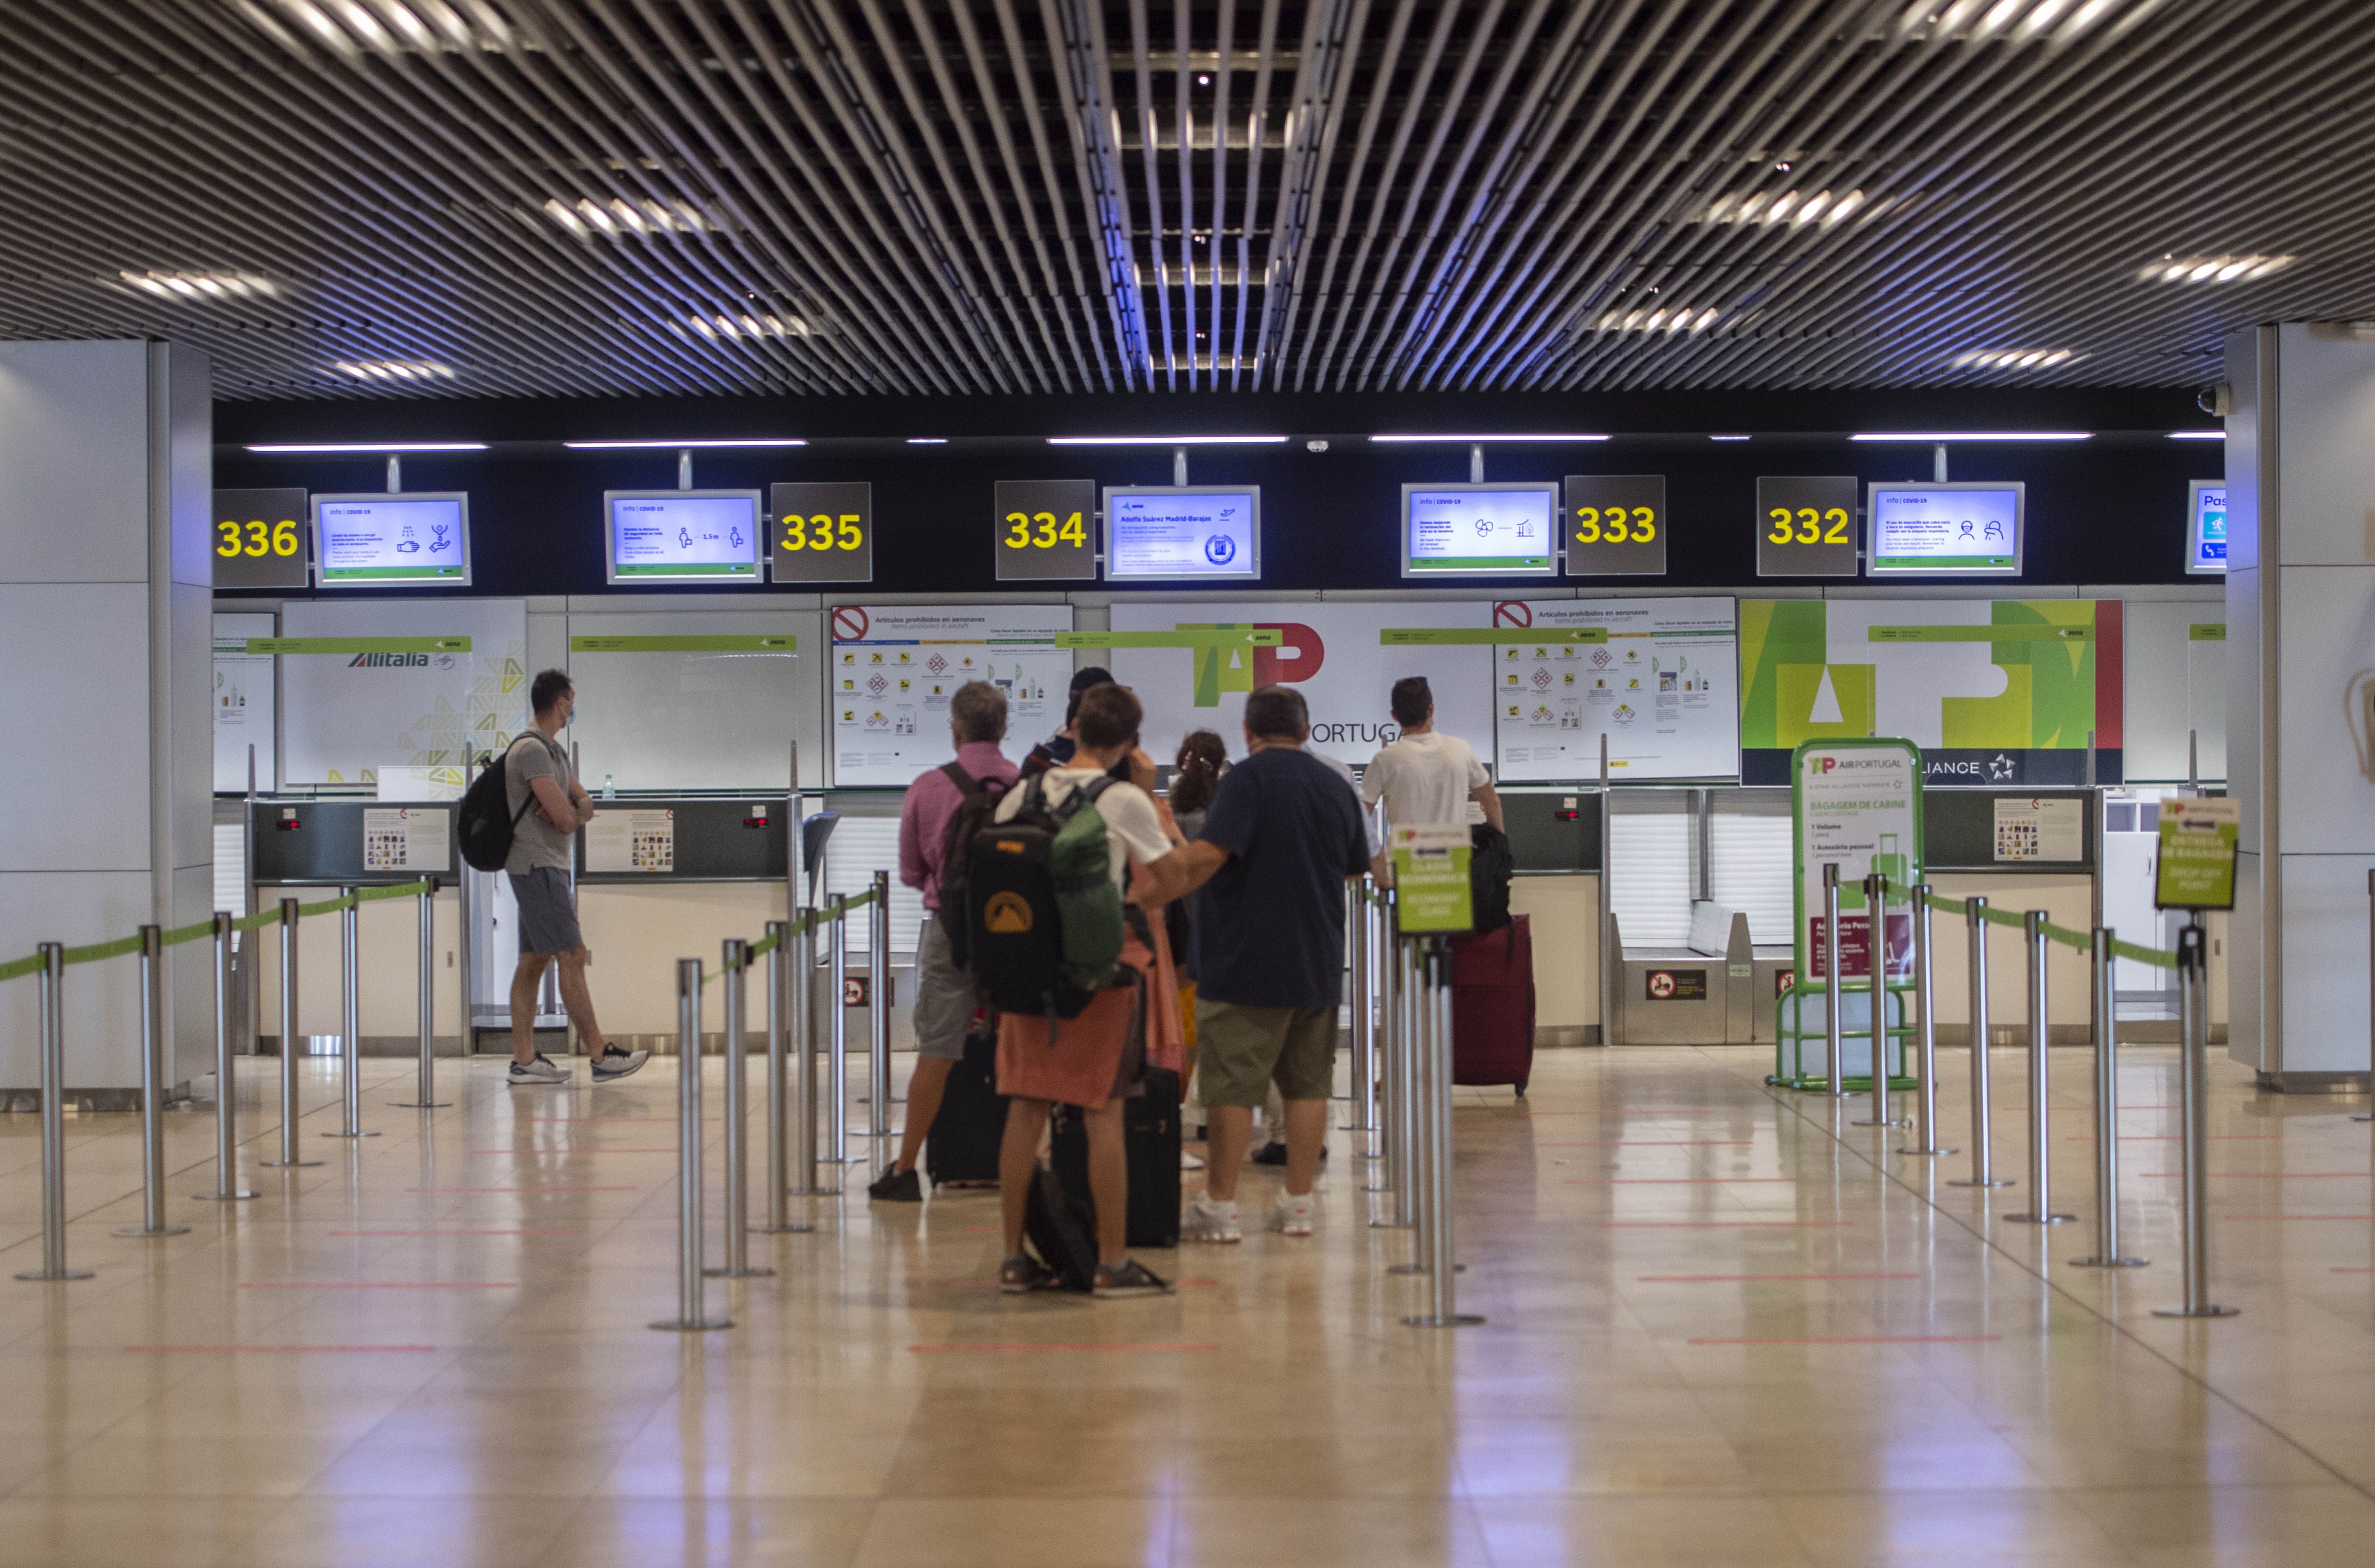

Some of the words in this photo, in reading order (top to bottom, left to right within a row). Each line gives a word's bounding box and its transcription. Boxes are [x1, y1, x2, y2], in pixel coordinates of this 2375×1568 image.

[217, 521, 298, 556] 336
[780, 515, 862, 551] 335
[1004, 512, 1086, 548] 334
[1575, 506, 1656, 543] 333
[1768, 508, 1848, 544] 332
[348, 653, 429, 667] Alitalia
[1312, 724, 1404, 743] ORTUG
[1809, 757, 1836, 774] TAP
[1810, 801, 1858, 810] BAGAGEM
[1873, 800, 1906, 809] CABINE
